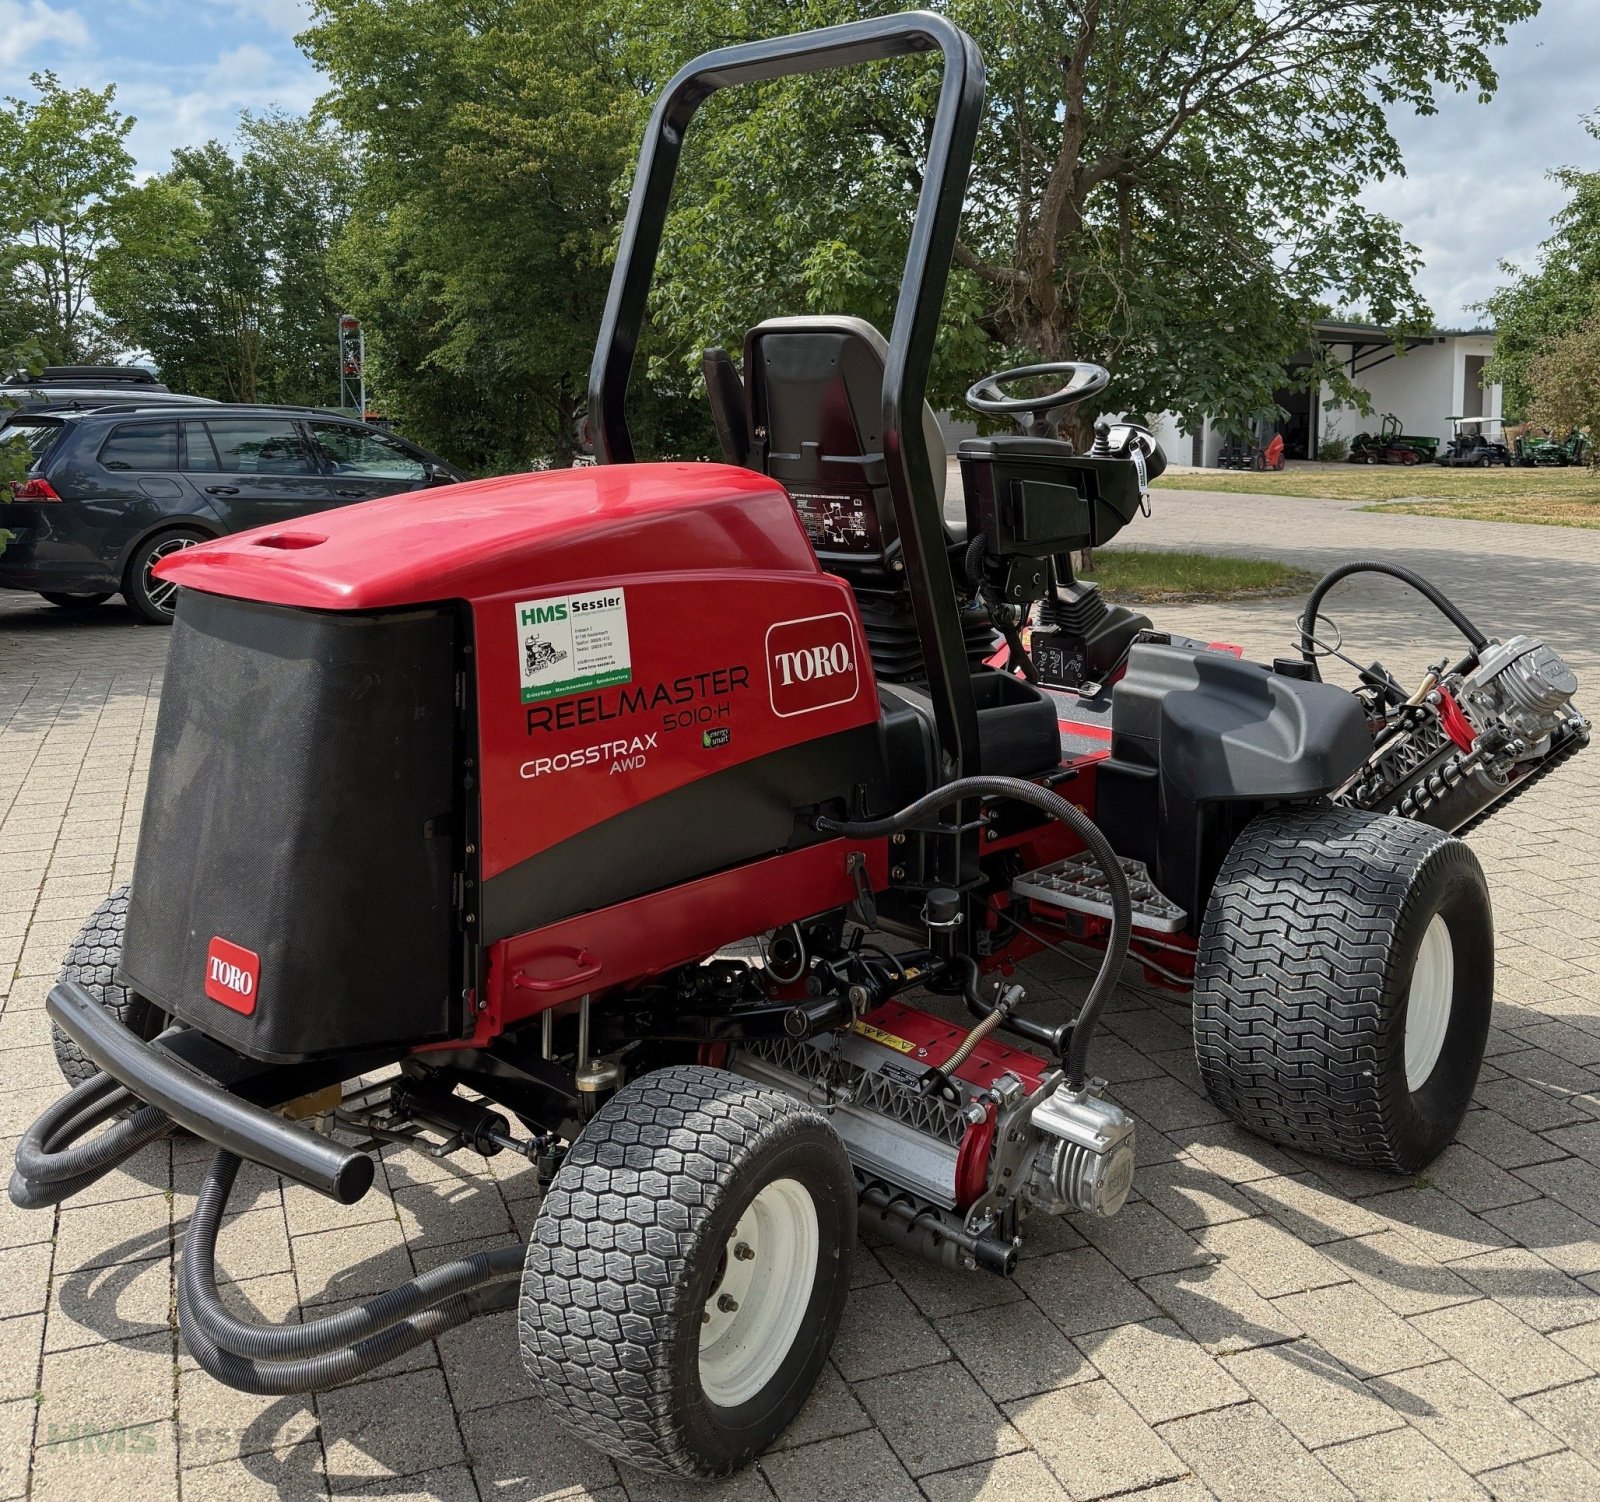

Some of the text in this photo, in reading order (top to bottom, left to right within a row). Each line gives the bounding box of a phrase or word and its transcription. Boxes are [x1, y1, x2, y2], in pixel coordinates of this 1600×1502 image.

[521, 604, 568, 626] HMS
[572, 597, 621, 612] Sessler
[527, 665, 750, 736] REELMASTER
[712, 735, 729, 745] smart
[519, 732, 658, 779] CROSSTRAX
[609, 755, 646, 775] AWD
[211, 955, 253, 995] TORO
